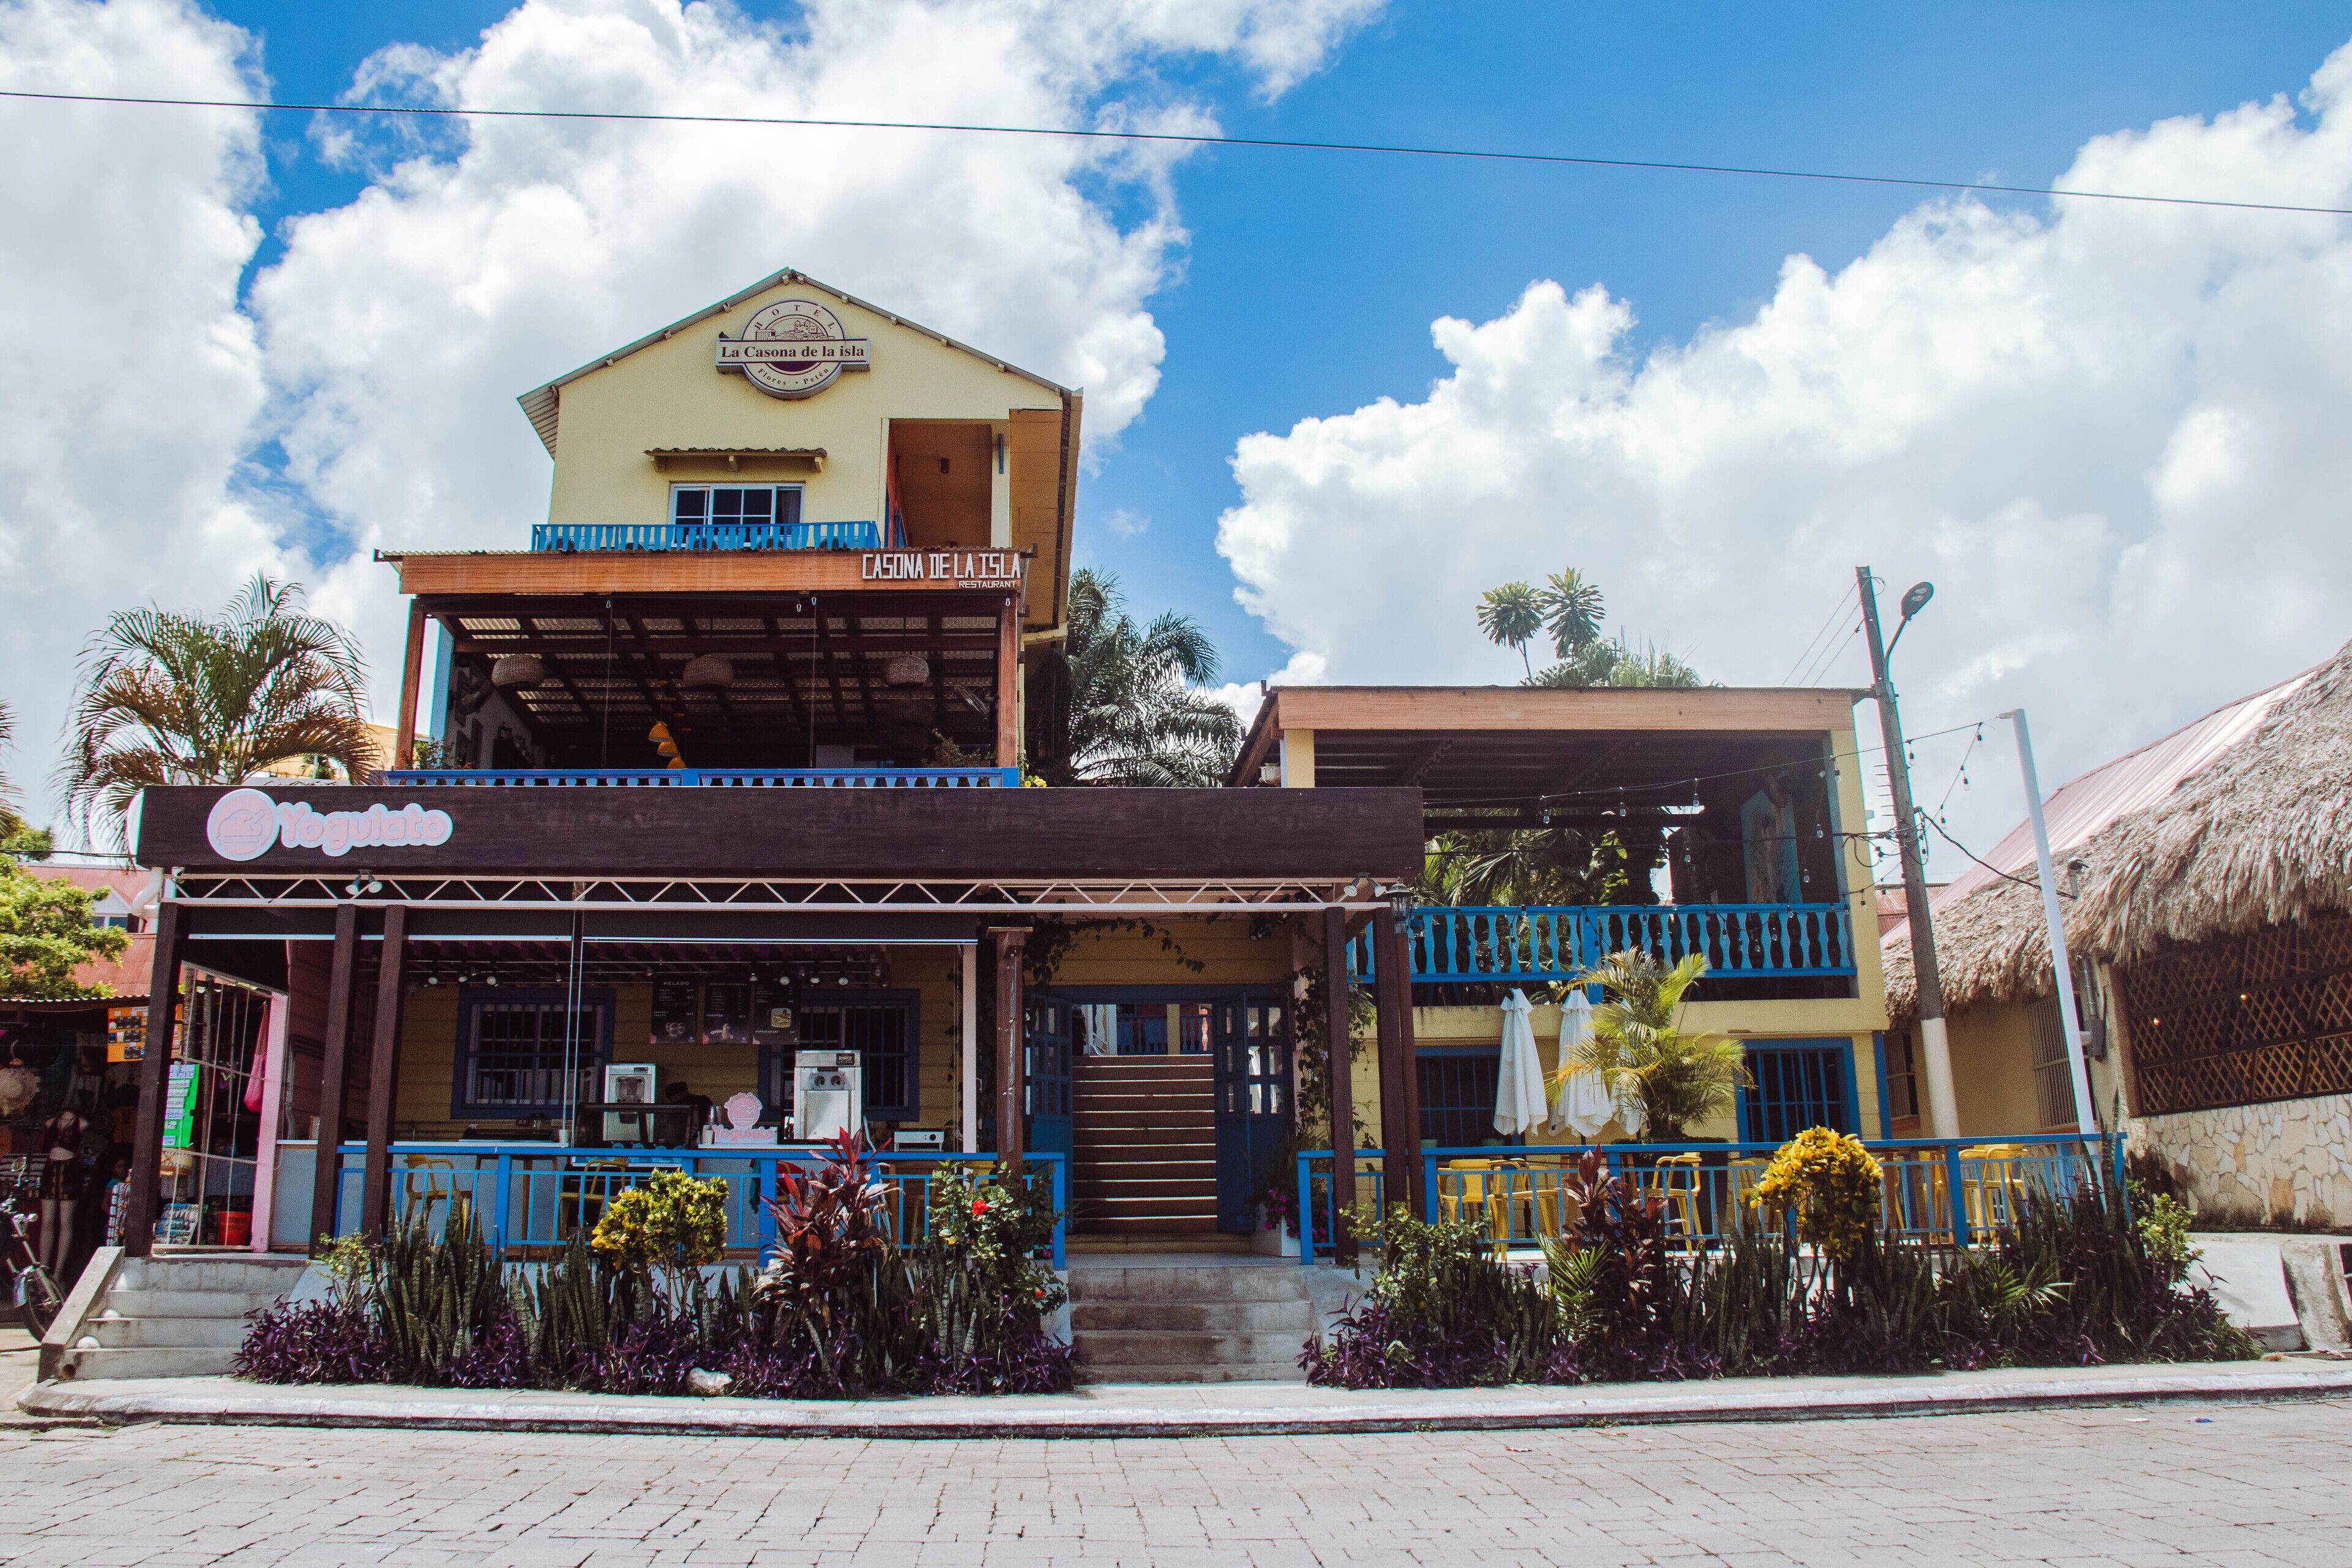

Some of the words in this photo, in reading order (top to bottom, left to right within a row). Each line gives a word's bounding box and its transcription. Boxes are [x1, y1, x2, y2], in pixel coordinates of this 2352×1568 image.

[754, 304, 835, 330] HOTEL
[721, 346, 739, 358] La
[744, 346, 796, 357] Casona
[801, 345, 818, 357] de
[822, 345, 834, 356] la
[840, 345, 864, 356] isla
[758, 368, 787, 386] Flores
[804, 368, 829, 385] Petén
[862, 553, 924, 579] CASONA
[929, 553, 950, 578] DE
[954, 553, 974, 578] LA
[979, 553, 1021, 578] ISLA
[281, 806, 447, 851] Yogulato
[712, 1125, 775, 1142] Yogulato
